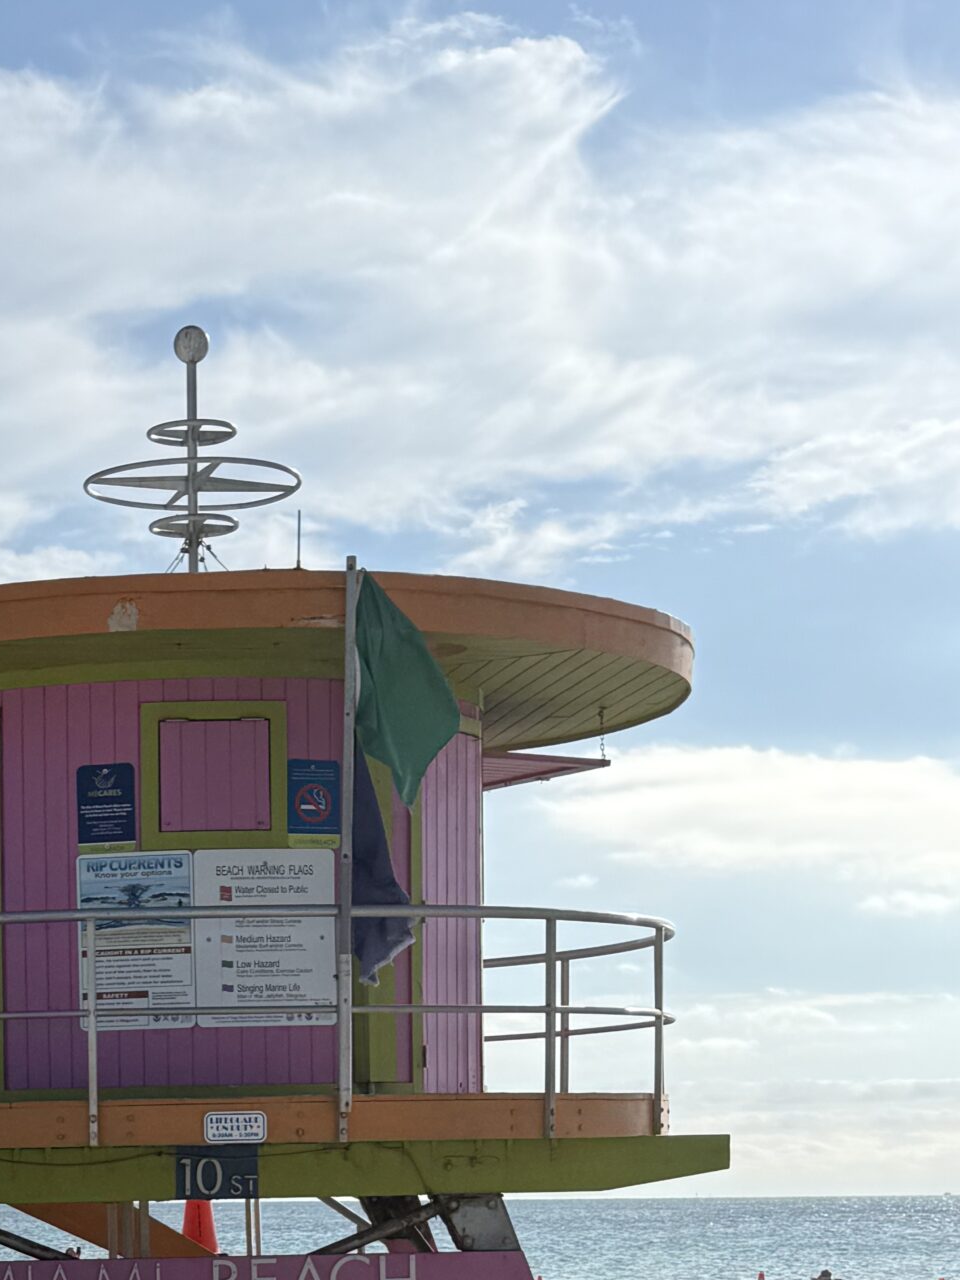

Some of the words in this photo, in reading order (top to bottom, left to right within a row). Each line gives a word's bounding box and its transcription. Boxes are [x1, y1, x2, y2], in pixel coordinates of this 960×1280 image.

[87, 860, 108, 873] RIP
[109, 857, 183, 871] CURRENTS
[215, 865, 244, 876] BEACH
[247, 864, 285, 876] WARNING
[289, 864, 314, 876] FLAGS
[94, 871, 118, 879] Know
[234, 885, 255, 894] Water
[256, 885, 279, 894] Closed
[280, 885, 287, 893] to
[288, 884, 308, 893] Public
[235, 935, 265, 944] Medium
[266, 934, 291, 943] Hazard
[236, 960, 252, 968] Low
[253, 959, 280, 968] Hazard
[237, 984, 264, 994] Stinging
[265, 983, 287, 992] Marine
[289, 983, 301, 991] Life
[179, 1157, 223, 1196] 10
[230, 1175, 258, 1196] ST
